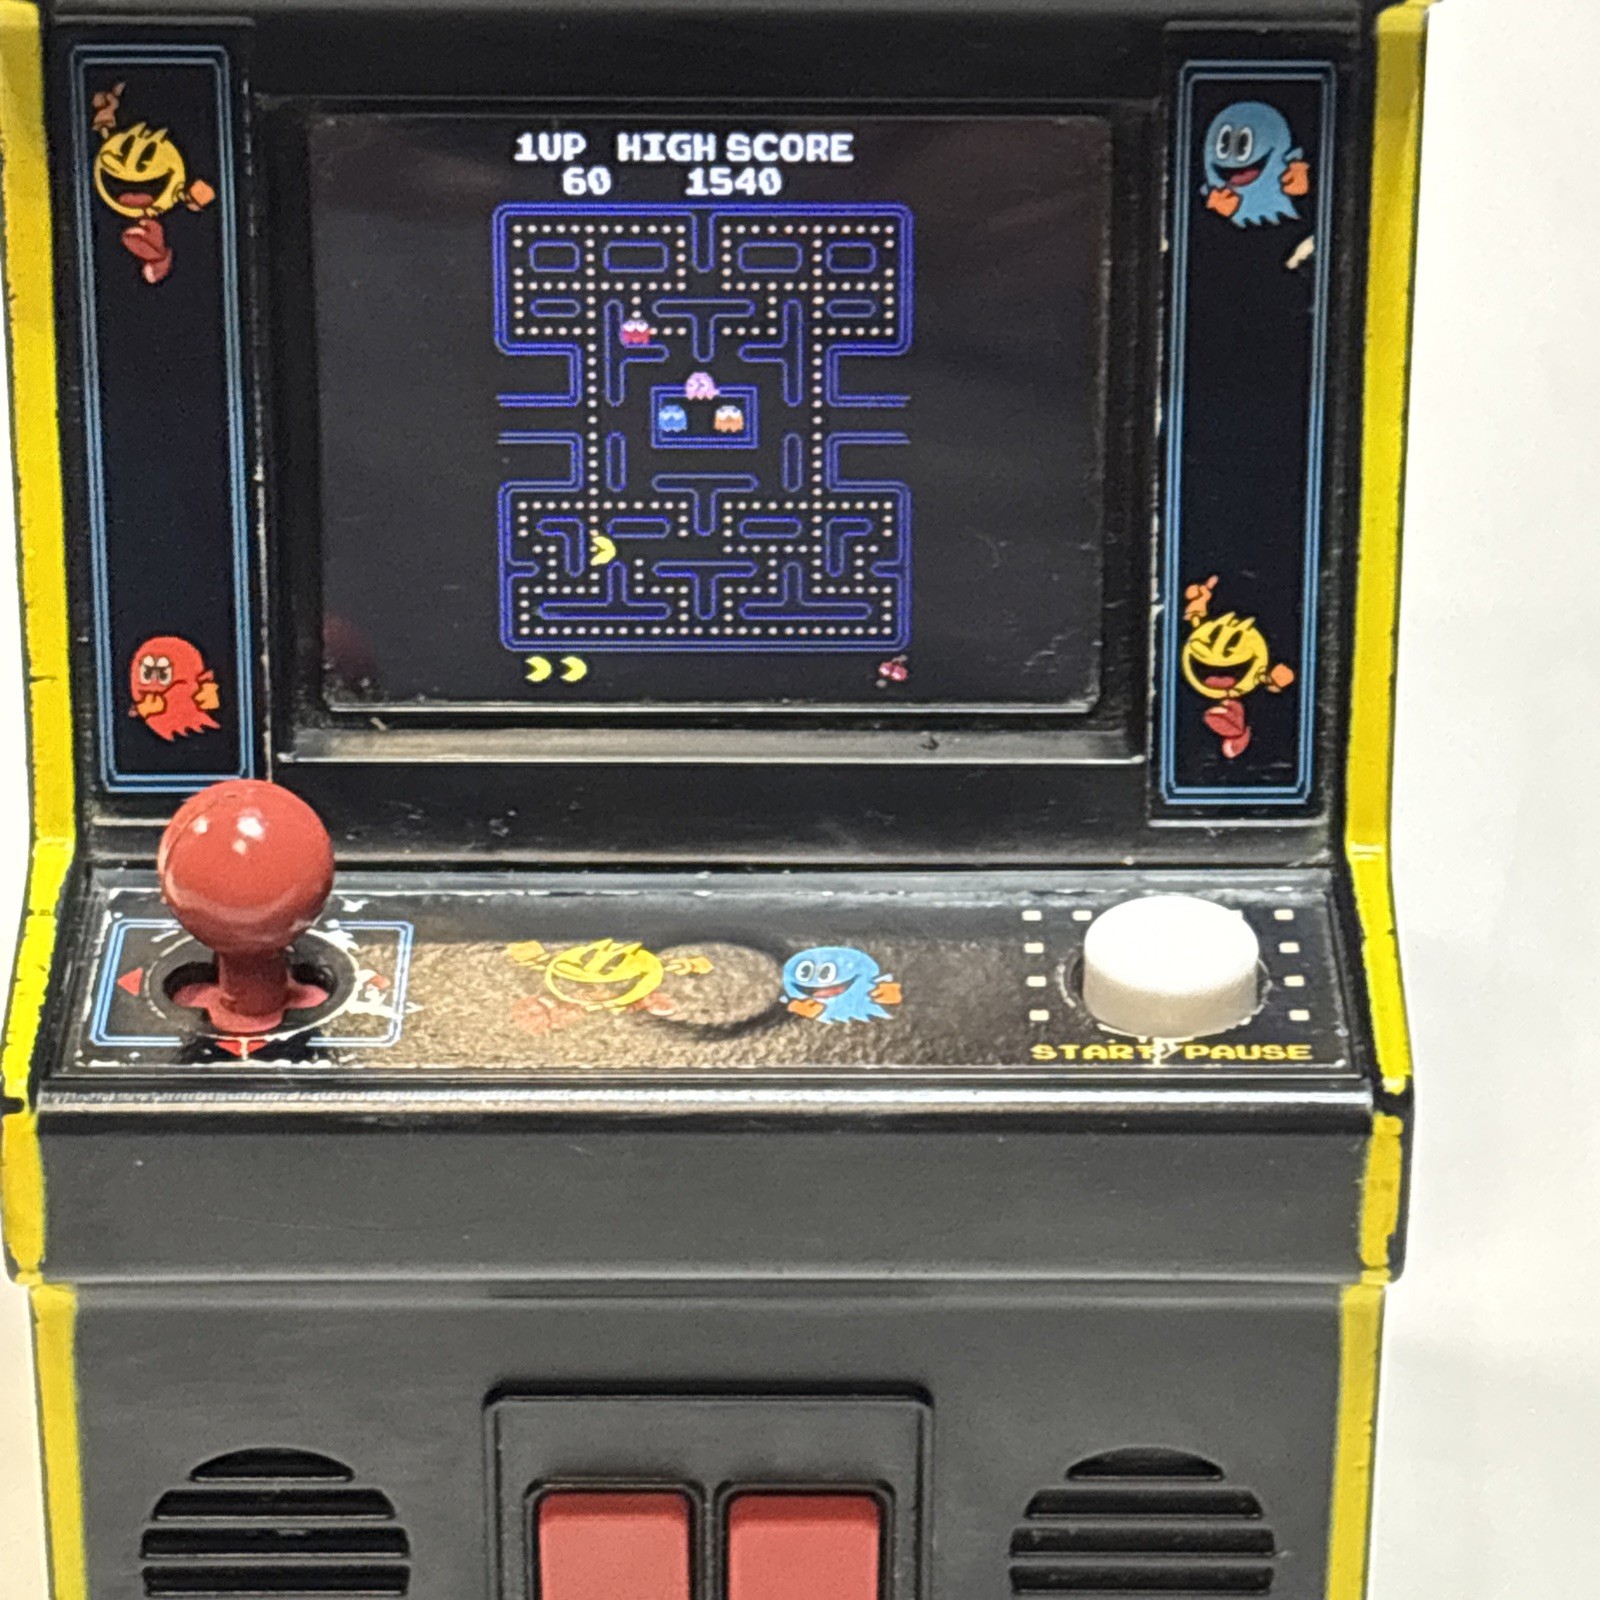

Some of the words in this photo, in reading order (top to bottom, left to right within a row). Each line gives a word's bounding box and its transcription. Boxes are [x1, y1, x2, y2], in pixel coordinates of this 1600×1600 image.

[514, 132, 586, 162] 1UP
[617, 132, 717, 162] HIGH
[726, 132, 854, 162] SCORE
[562, 167, 612, 195] 60
[685, 167, 782, 195] 1540
